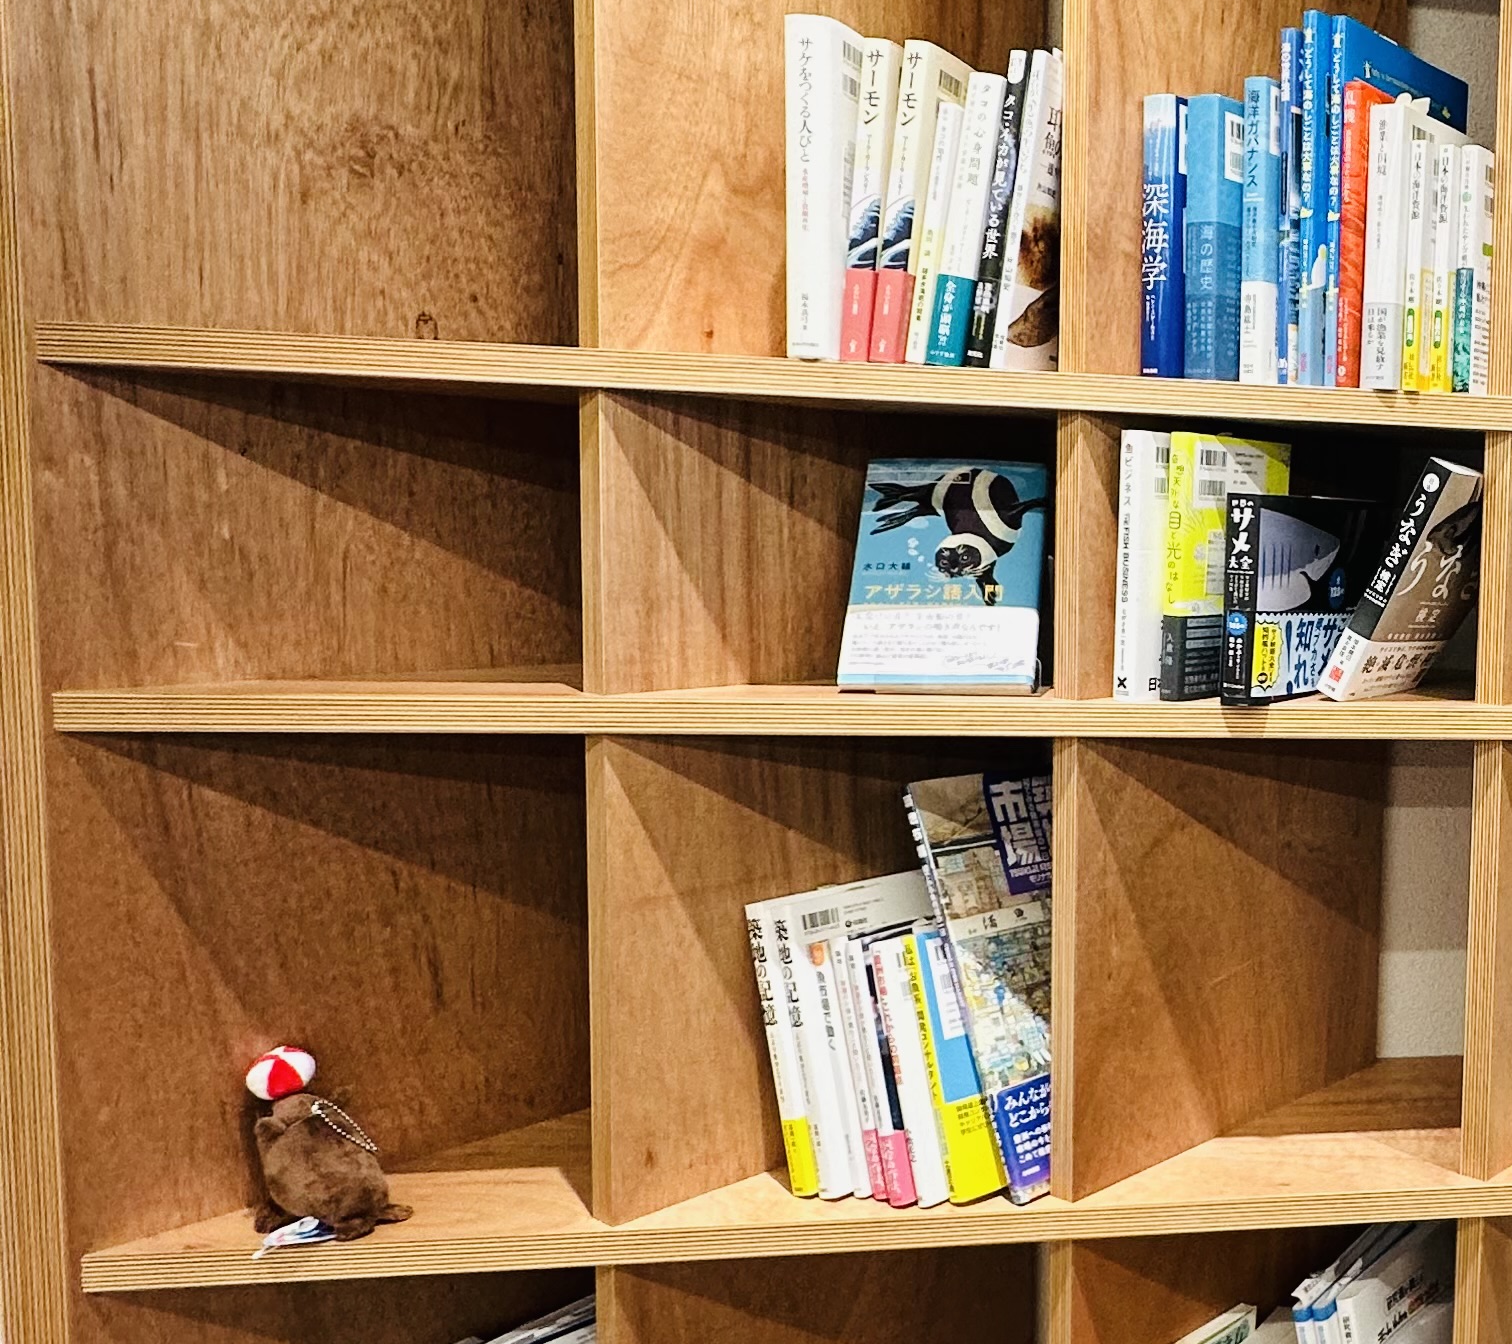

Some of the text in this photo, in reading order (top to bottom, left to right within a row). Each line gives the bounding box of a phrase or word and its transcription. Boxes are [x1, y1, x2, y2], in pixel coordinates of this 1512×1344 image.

[799, 37, 814, 163] サケをつくる人びと
[864, 50, 883, 126] サーモン
[901, 52, 922, 126] サーモン
[966, 84, 991, 187] タコの心身問題
[1247, 90, 1260, 188] 海洋ガバナンス
[982, 94, 1017, 259] タコ・イカが見ている世界
[1142, 184, 1169, 290] 深海学
[1200, 225, 1213, 289] 海の歴史
[1122, 442, 1133, 507] 魚ビジネス
[1385, 494, 1427, 569] うなぎ
[864, 584, 1004, 602] アザラシ語入門
